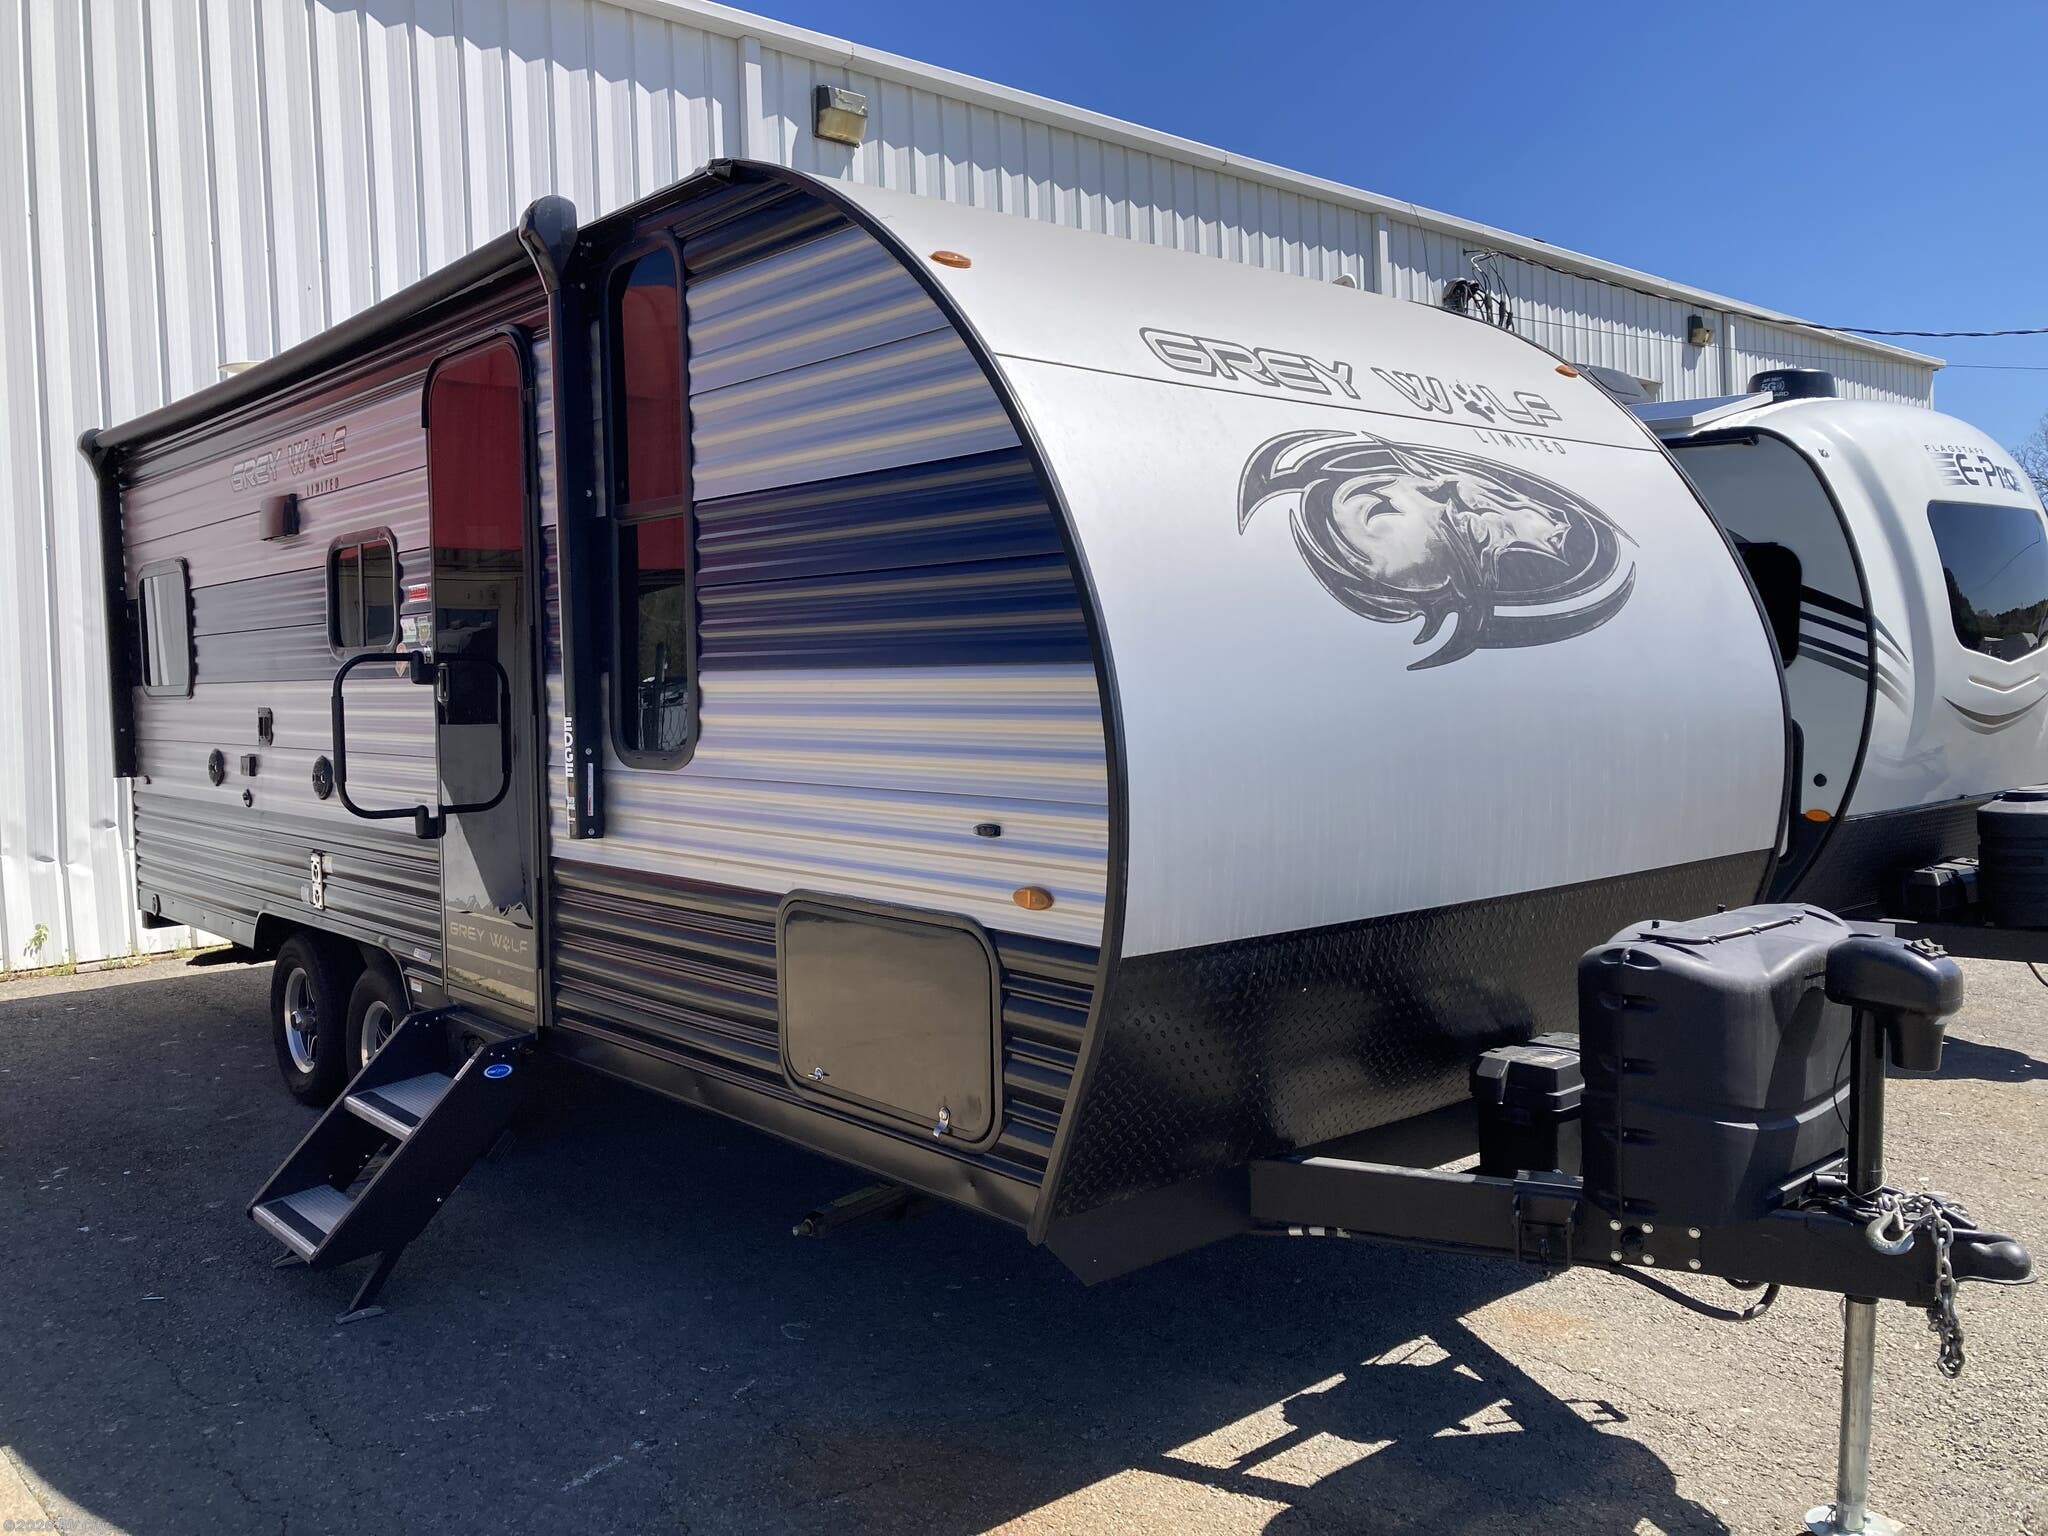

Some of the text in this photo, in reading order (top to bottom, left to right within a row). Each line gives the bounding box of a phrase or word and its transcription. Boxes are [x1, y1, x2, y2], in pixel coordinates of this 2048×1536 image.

[1138, 326, 1361, 400] GREY
[1472, 429, 1567, 455] LIMITED
[1923, 444, 1985, 455] FLAGSTAFF
[231, 448, 282, 493] GREY
[306, 477, 340, 497] LIMITED
[563, 716, 575, 778] EDGE
[449, 922, 485, 941] GREY
